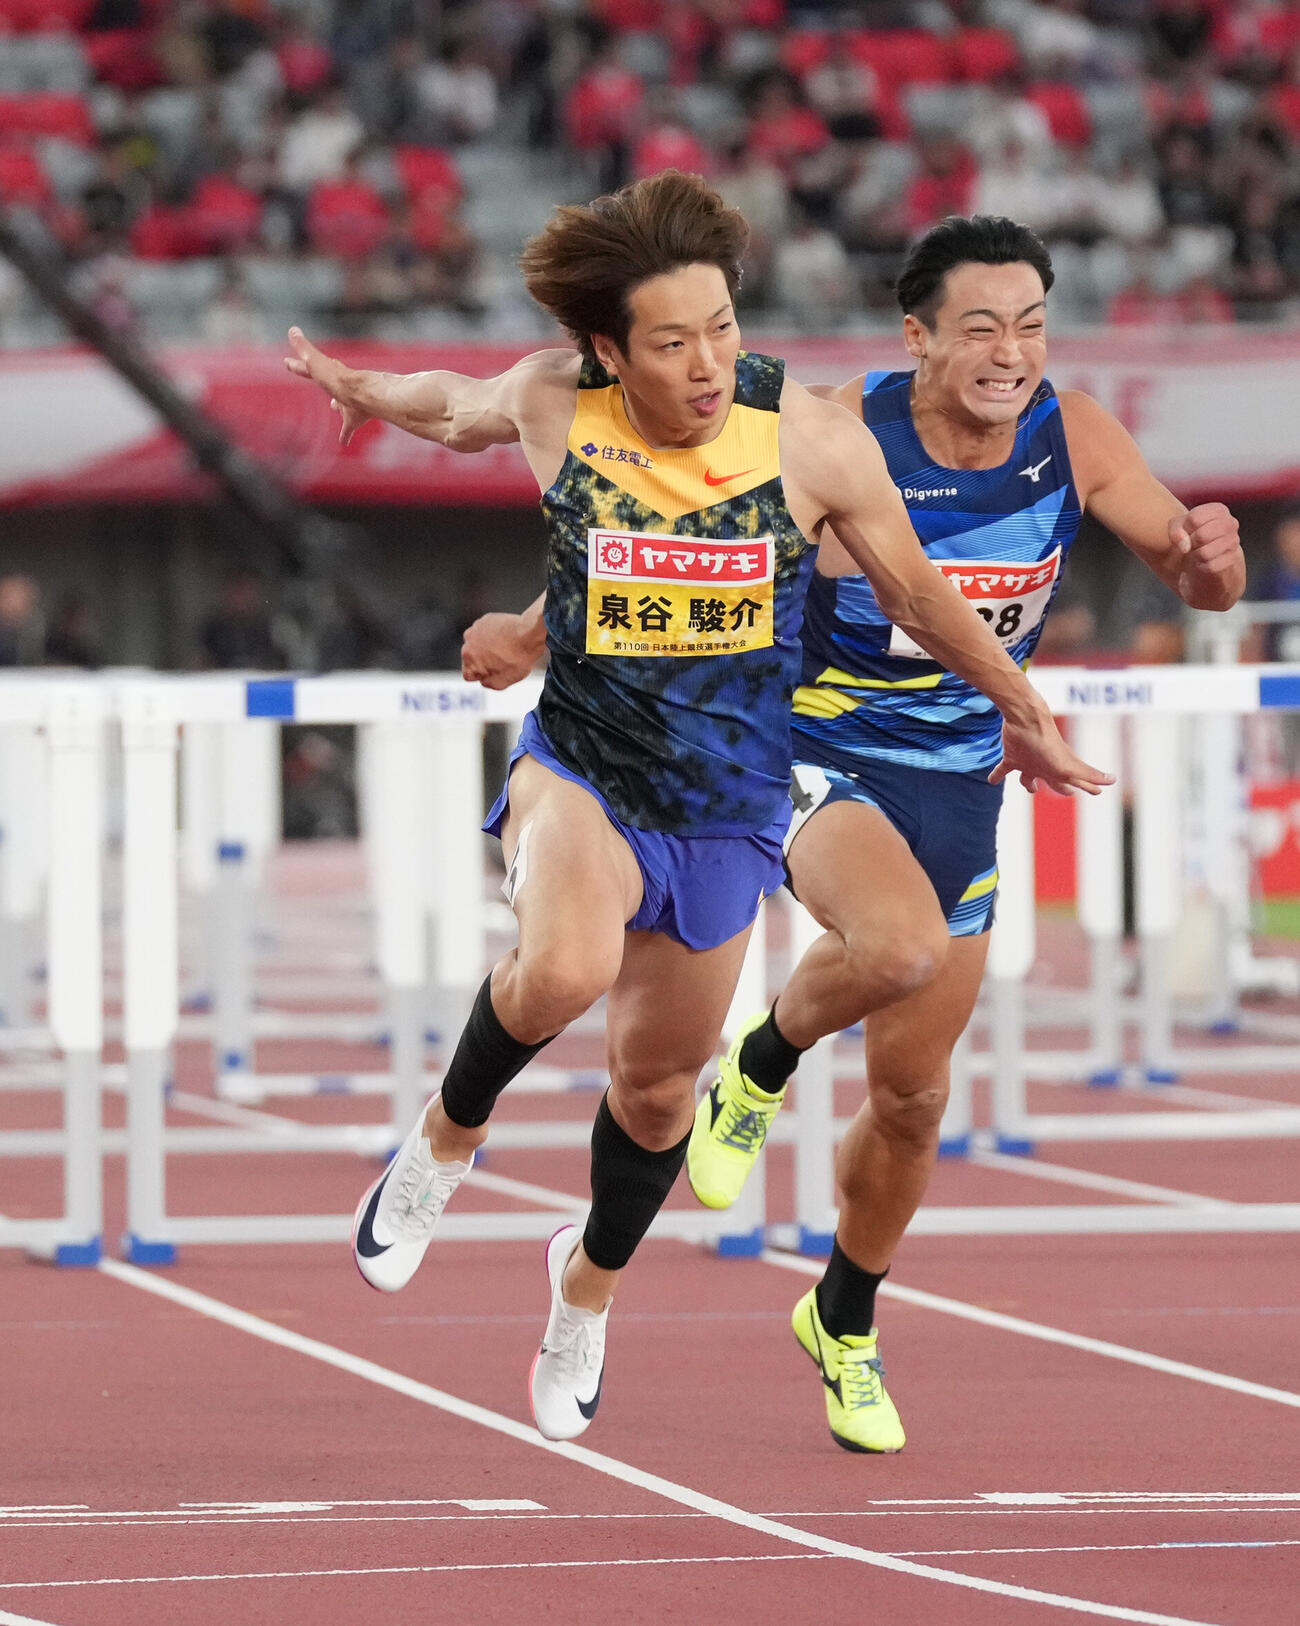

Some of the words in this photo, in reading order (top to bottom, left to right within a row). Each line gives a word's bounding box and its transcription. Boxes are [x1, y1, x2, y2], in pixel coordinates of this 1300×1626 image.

[601, 445, 654, 469] 住友電工
[904, 486, 958, 501] Digverse
[639, 546, 759, 574] ヤマザキ
[948, 566, 1052, 593] ヤマザキ
[597, 593, 673, 632] 泉谷
[688, 597, 763, 632] 駿介
[613, 641, 650, 652] 第110回
[402, 690, 486, 712] NISHI
[1068, 681, 1153, 705] NISHI
